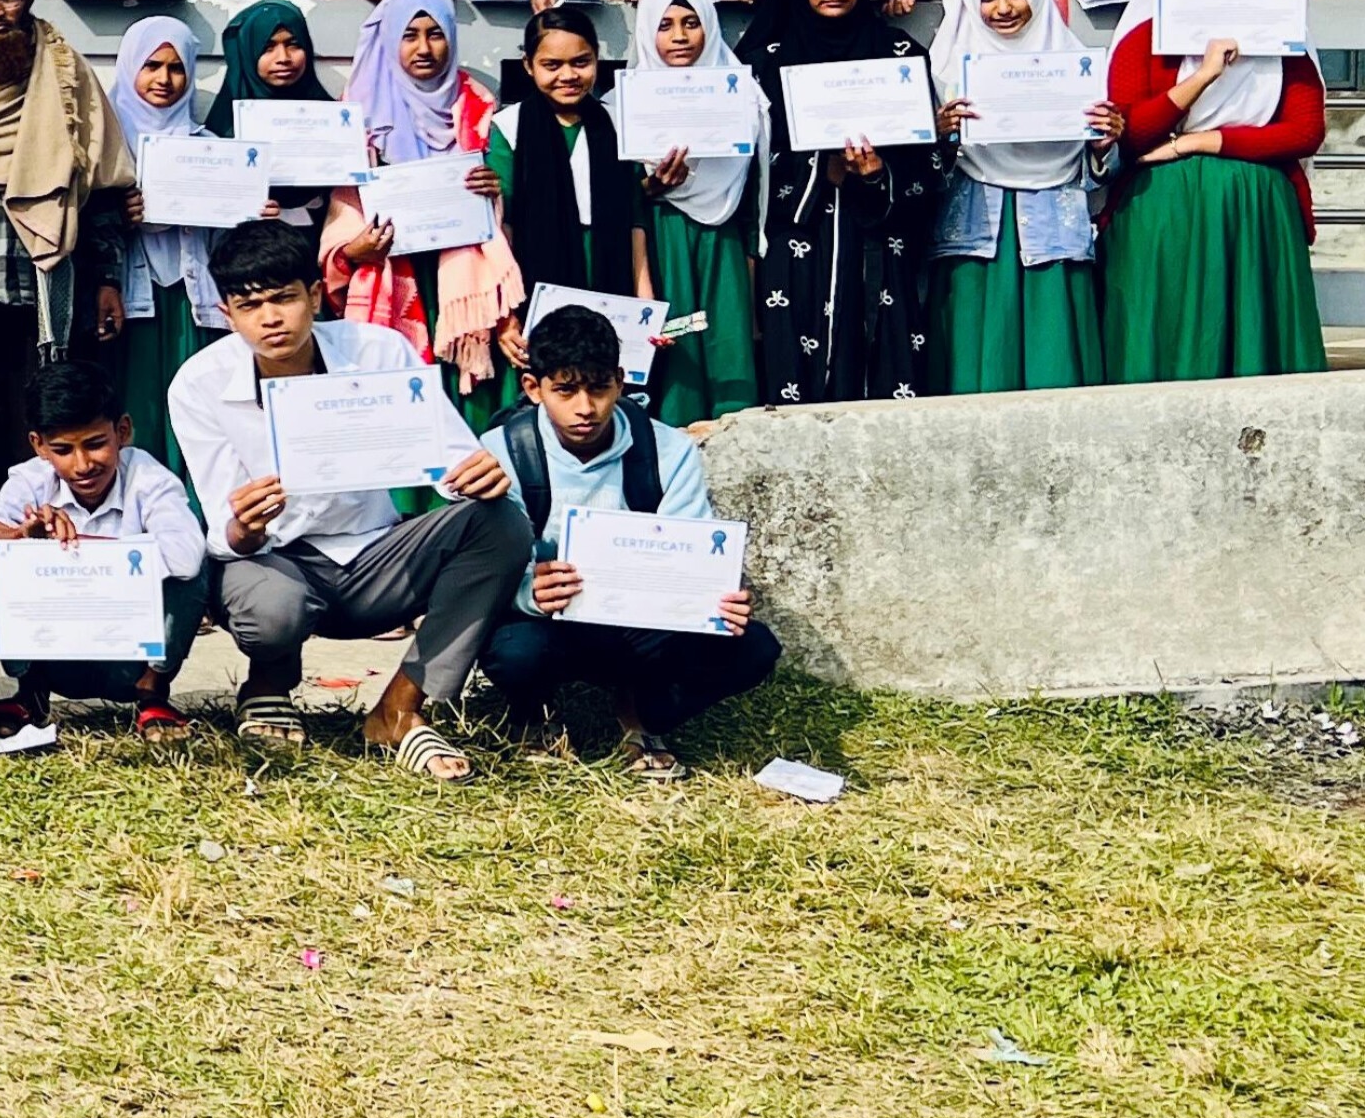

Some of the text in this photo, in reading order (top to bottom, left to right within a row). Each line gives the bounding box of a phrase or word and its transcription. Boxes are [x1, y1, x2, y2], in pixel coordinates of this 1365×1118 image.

[314, 394, 394, 411] CERTIFICATE
[612, 536, 693, 553] CERTIFICATE
[35, 565, 112, 577] CERTIFICATE
